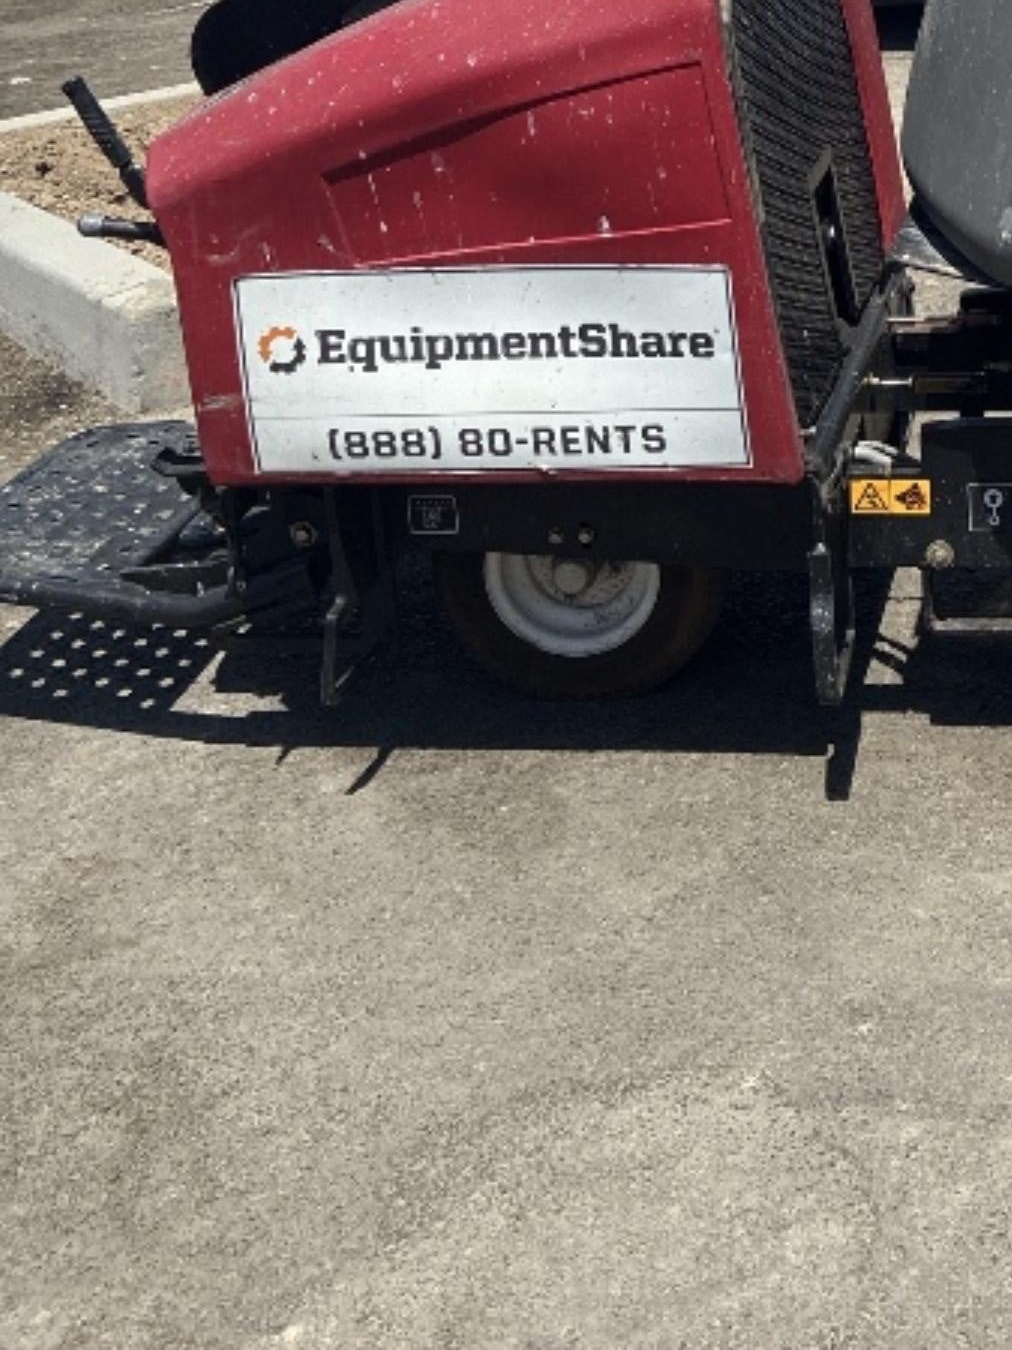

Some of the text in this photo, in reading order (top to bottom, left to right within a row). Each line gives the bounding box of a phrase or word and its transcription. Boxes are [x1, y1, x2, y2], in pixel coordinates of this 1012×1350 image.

[317, 323, 715, 372] EquipmentShare
[328, 424, 667, 461] (888) 80-RENTS
